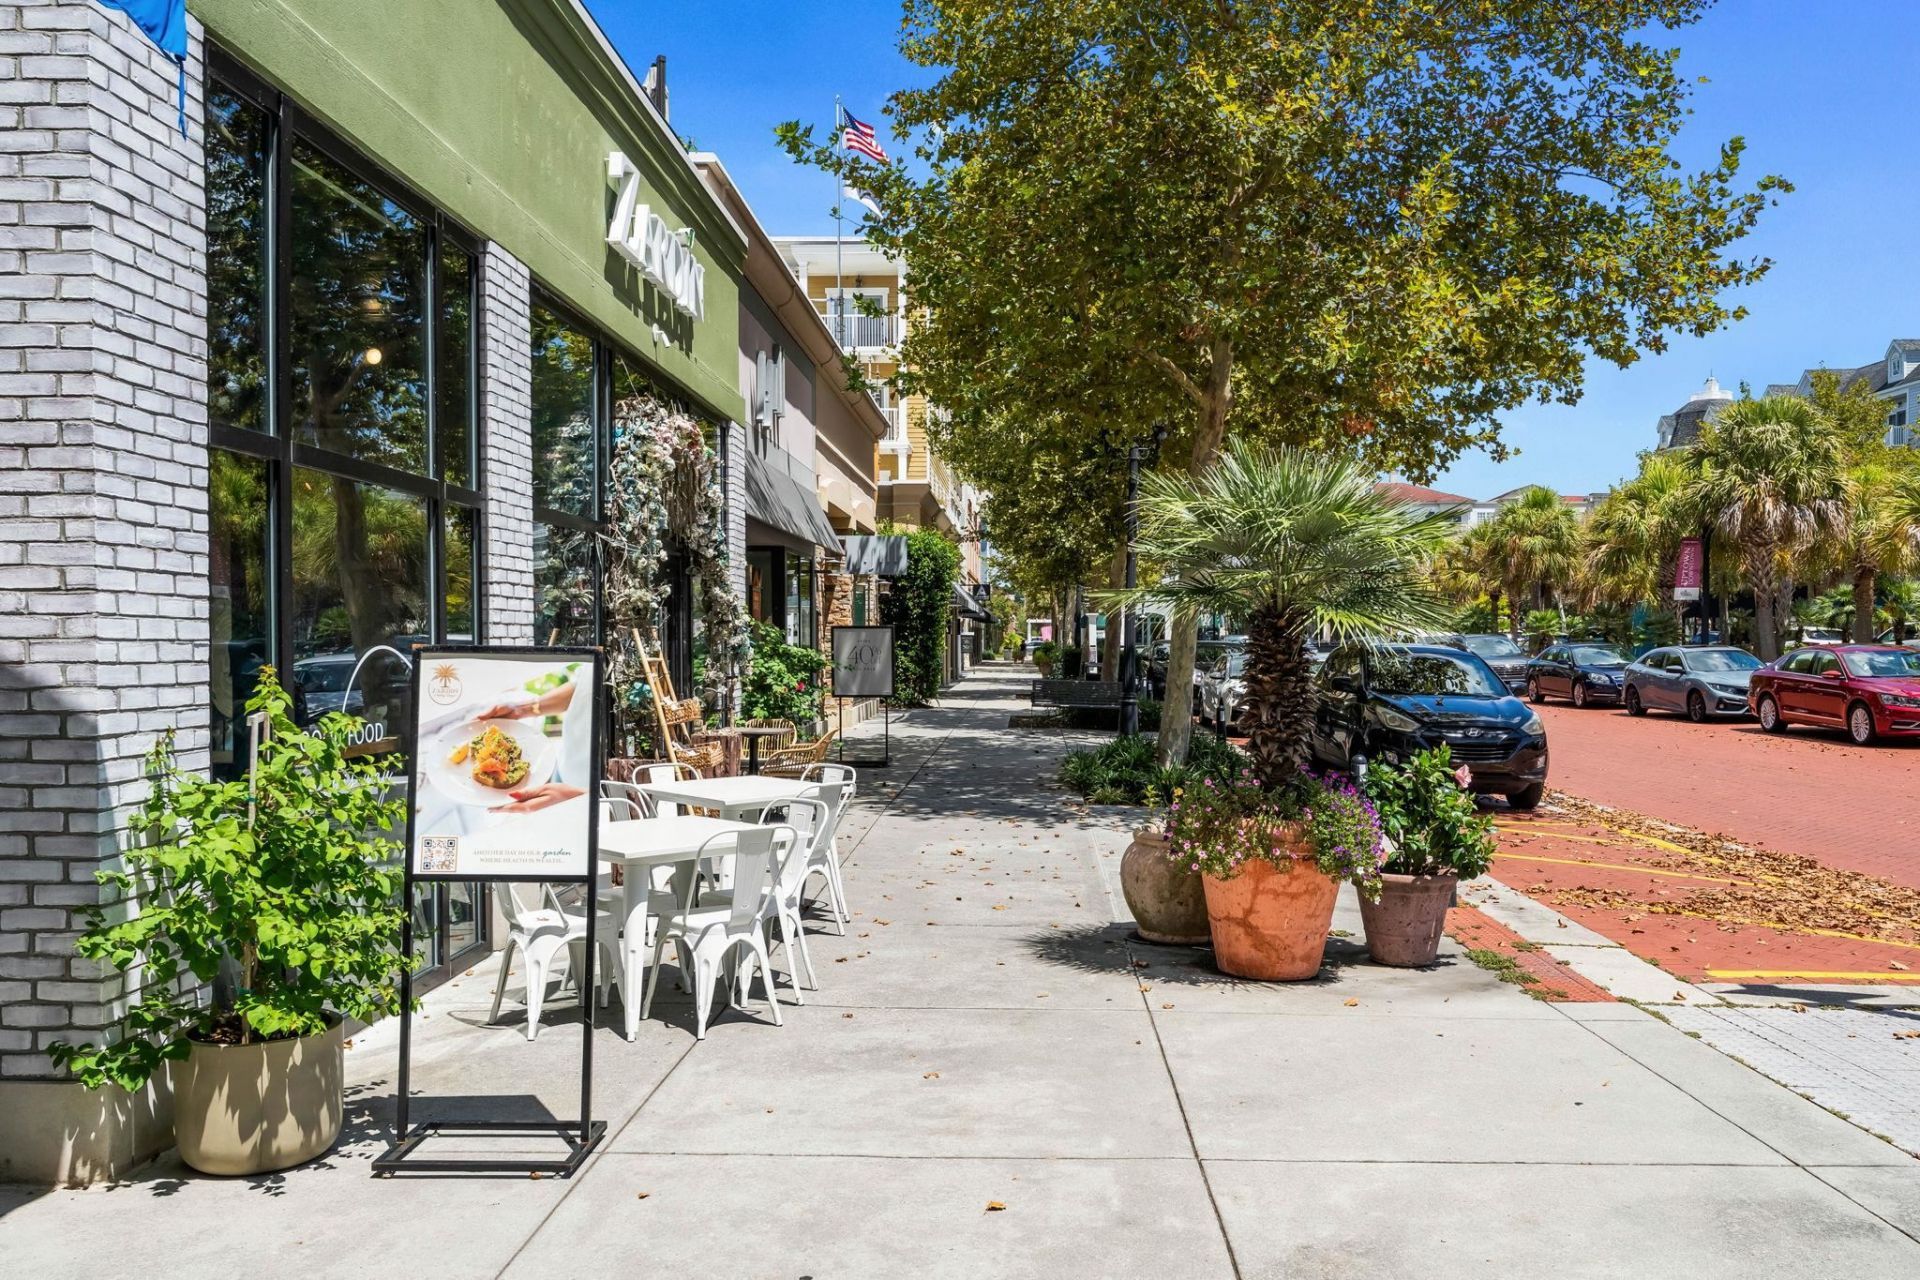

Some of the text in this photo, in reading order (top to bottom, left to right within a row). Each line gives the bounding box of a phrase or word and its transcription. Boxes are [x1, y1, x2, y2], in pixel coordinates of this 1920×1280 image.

[1681, 547, 1691, 586] UPTOWN
[348, 723, 384, 746] FOOD
[543, 848, 571, 859] garden
